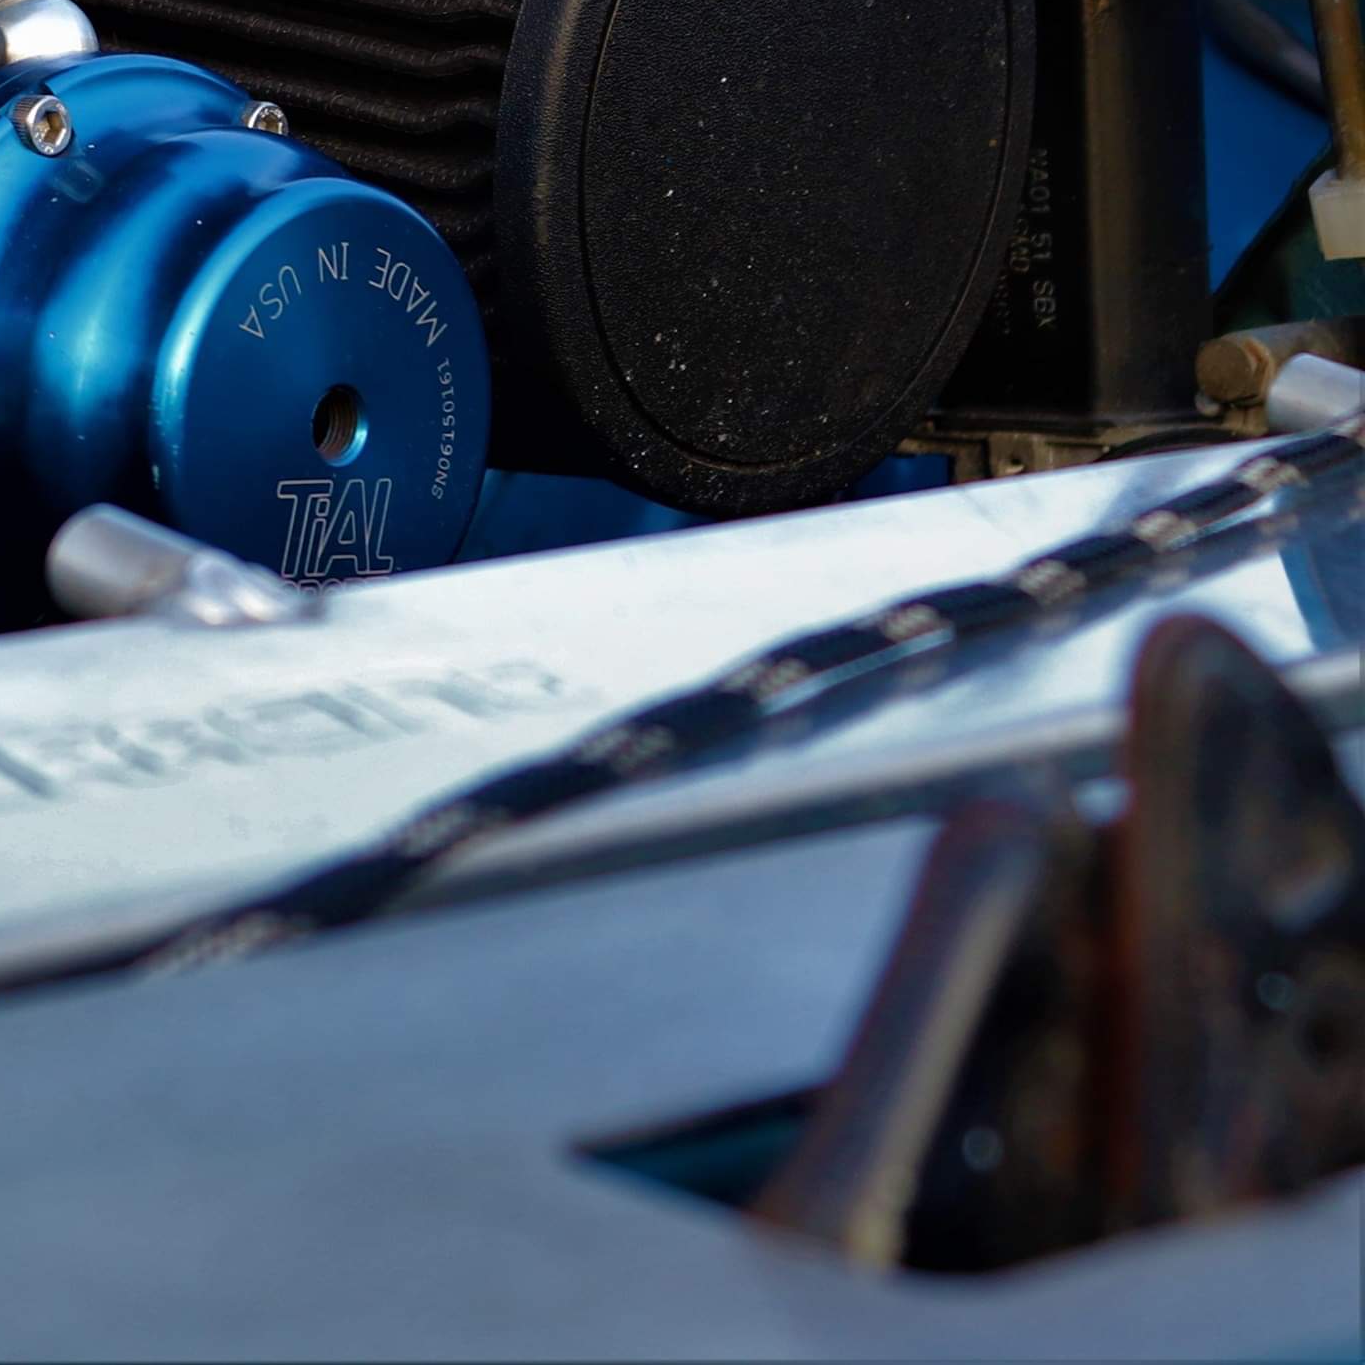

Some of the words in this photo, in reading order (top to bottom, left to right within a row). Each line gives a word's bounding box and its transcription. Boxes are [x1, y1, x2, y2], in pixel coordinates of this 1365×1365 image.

[317, 241, 350, 283] IN
[368, 246, 449, 348] MADE
[238, 264, 303, 340] USA
